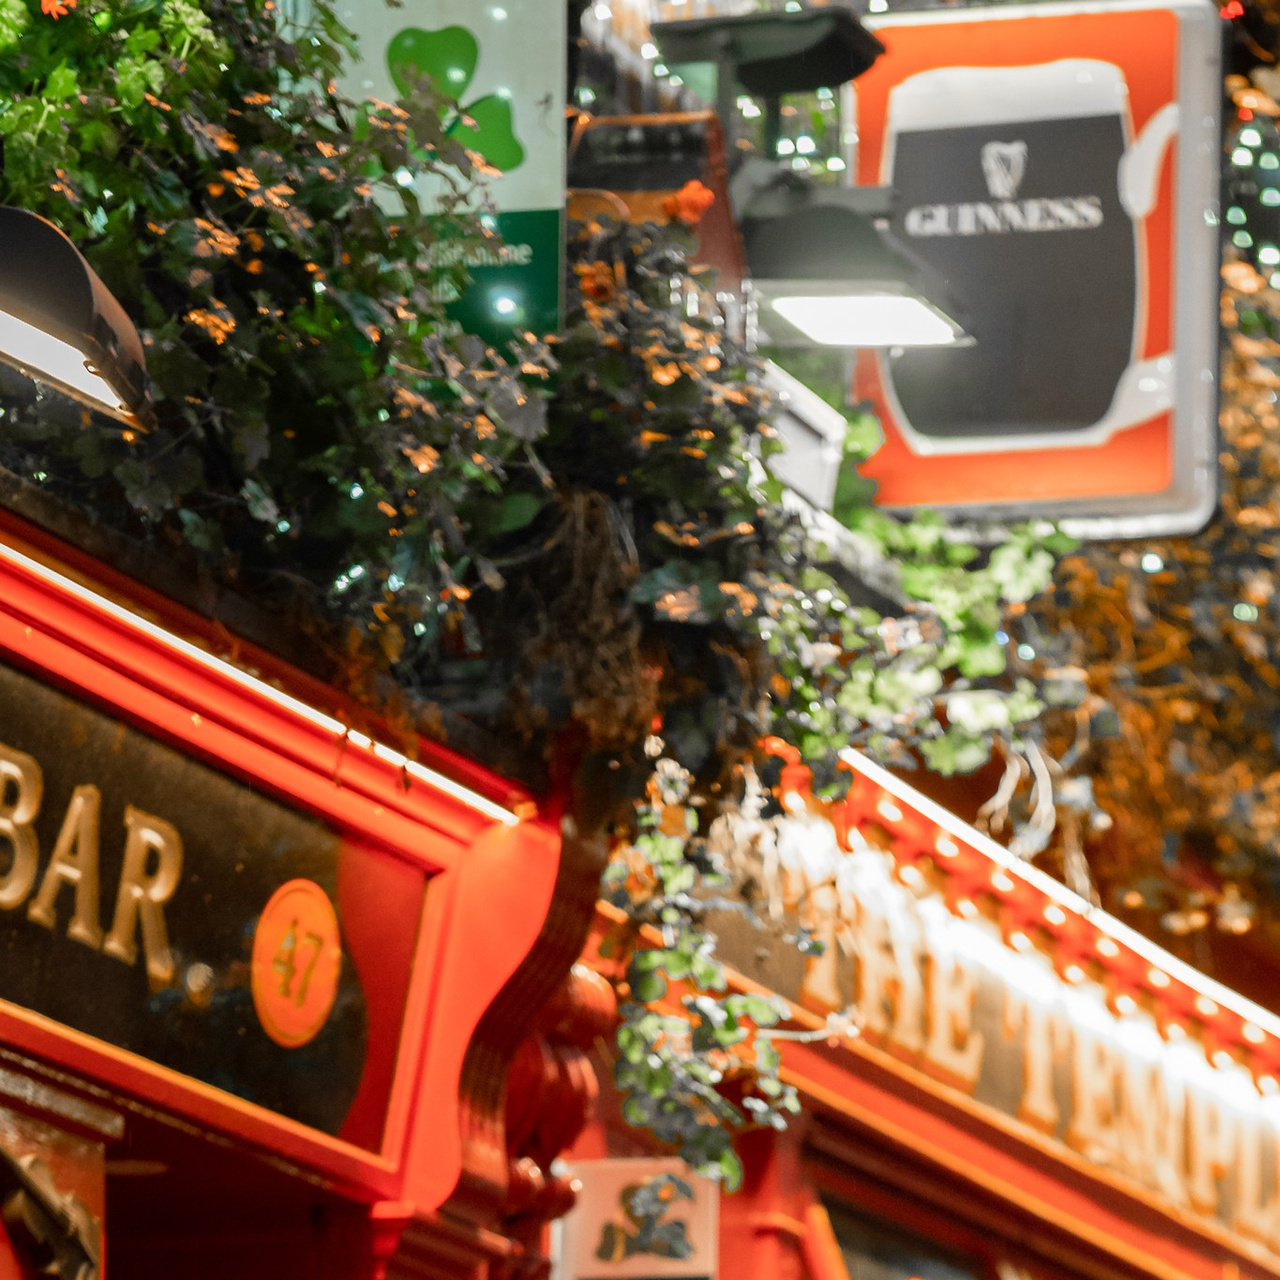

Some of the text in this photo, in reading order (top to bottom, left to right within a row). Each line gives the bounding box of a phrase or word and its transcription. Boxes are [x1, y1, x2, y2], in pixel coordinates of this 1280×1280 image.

[904, 196, 1104, 237] GUINNESS
[0, 742, 184, 984] BAR
[271, 917, 323, 1008] 47
